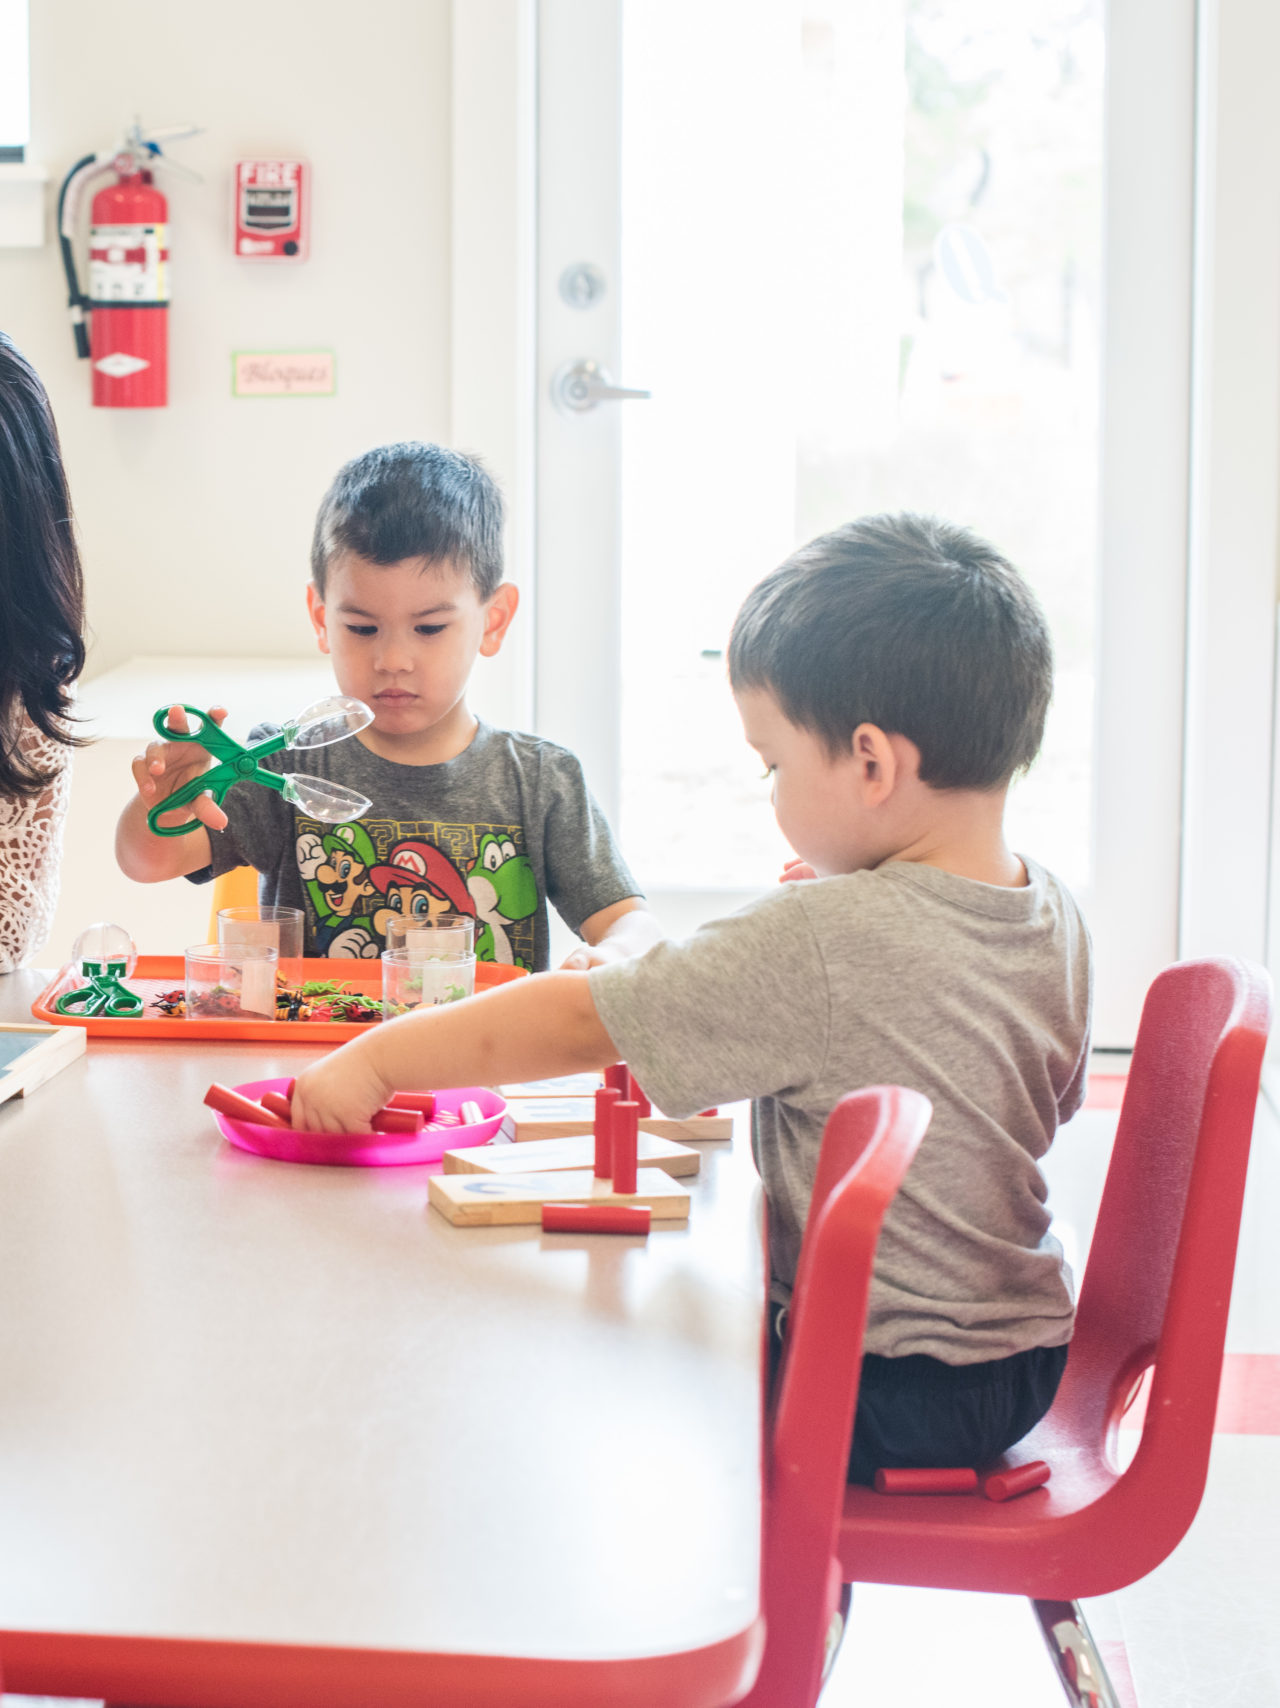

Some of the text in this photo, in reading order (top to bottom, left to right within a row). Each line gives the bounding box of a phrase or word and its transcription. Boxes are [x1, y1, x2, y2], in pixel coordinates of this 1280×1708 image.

[240, 161, 299, 186] FIRE
[240, 359, 328, 389] Bloques
[396, 855, 422, 874] M
